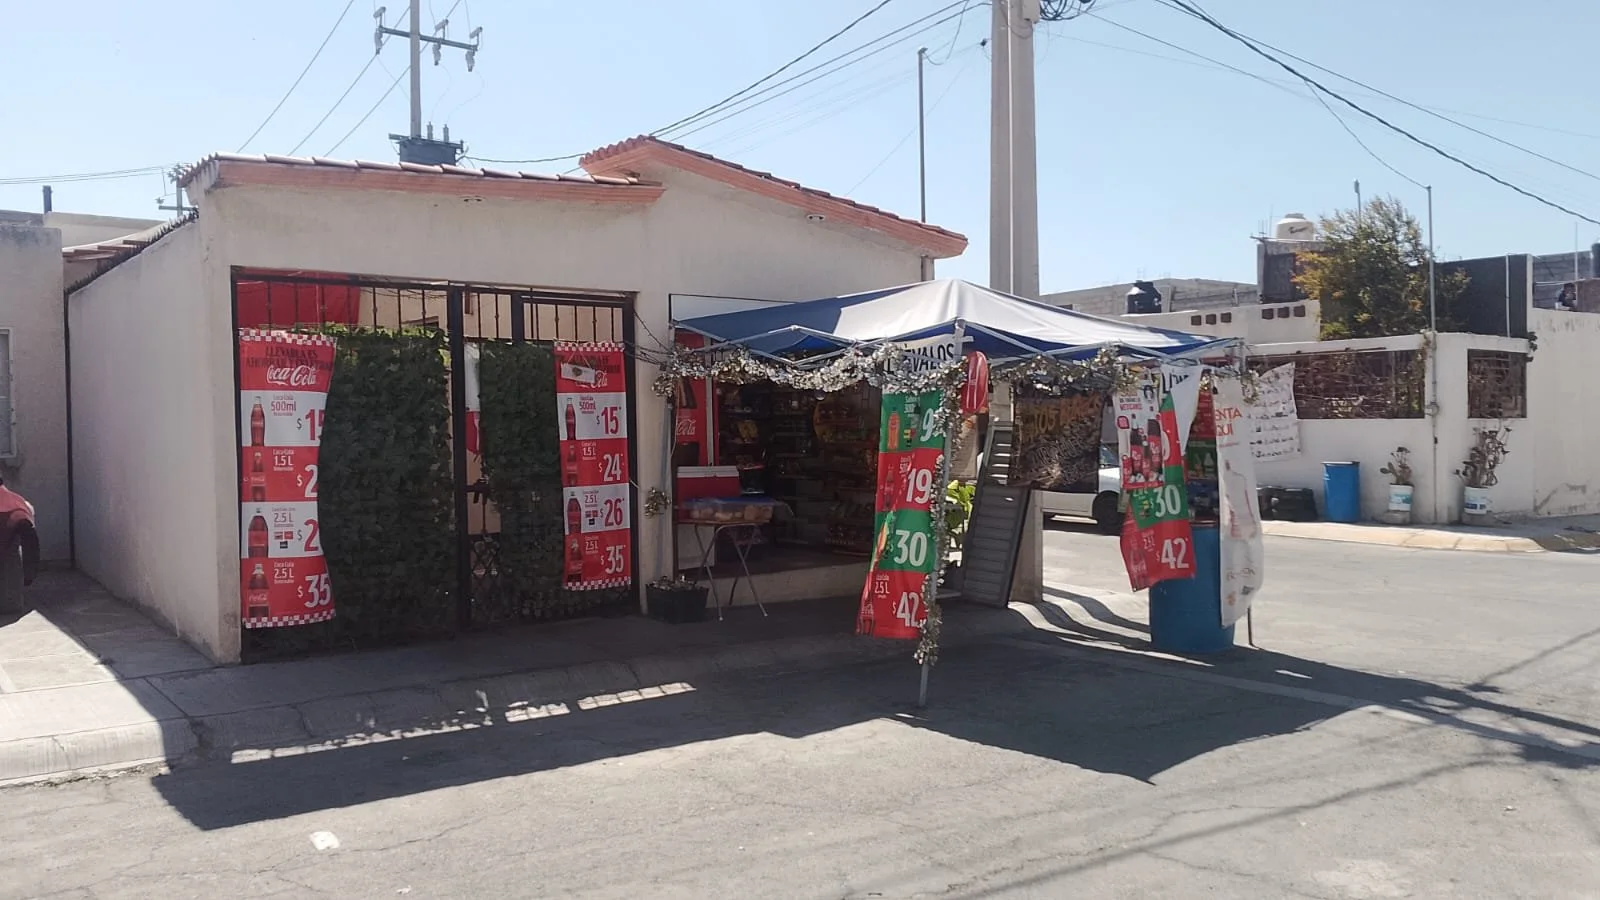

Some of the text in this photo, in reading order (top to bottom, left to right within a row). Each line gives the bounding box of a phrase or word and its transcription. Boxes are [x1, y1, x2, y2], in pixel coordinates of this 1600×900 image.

[266, 364, 318, 387] Coca-Cola
[271, 401, 297, 412] 500ml
[906, 468, 932, 504] 19
